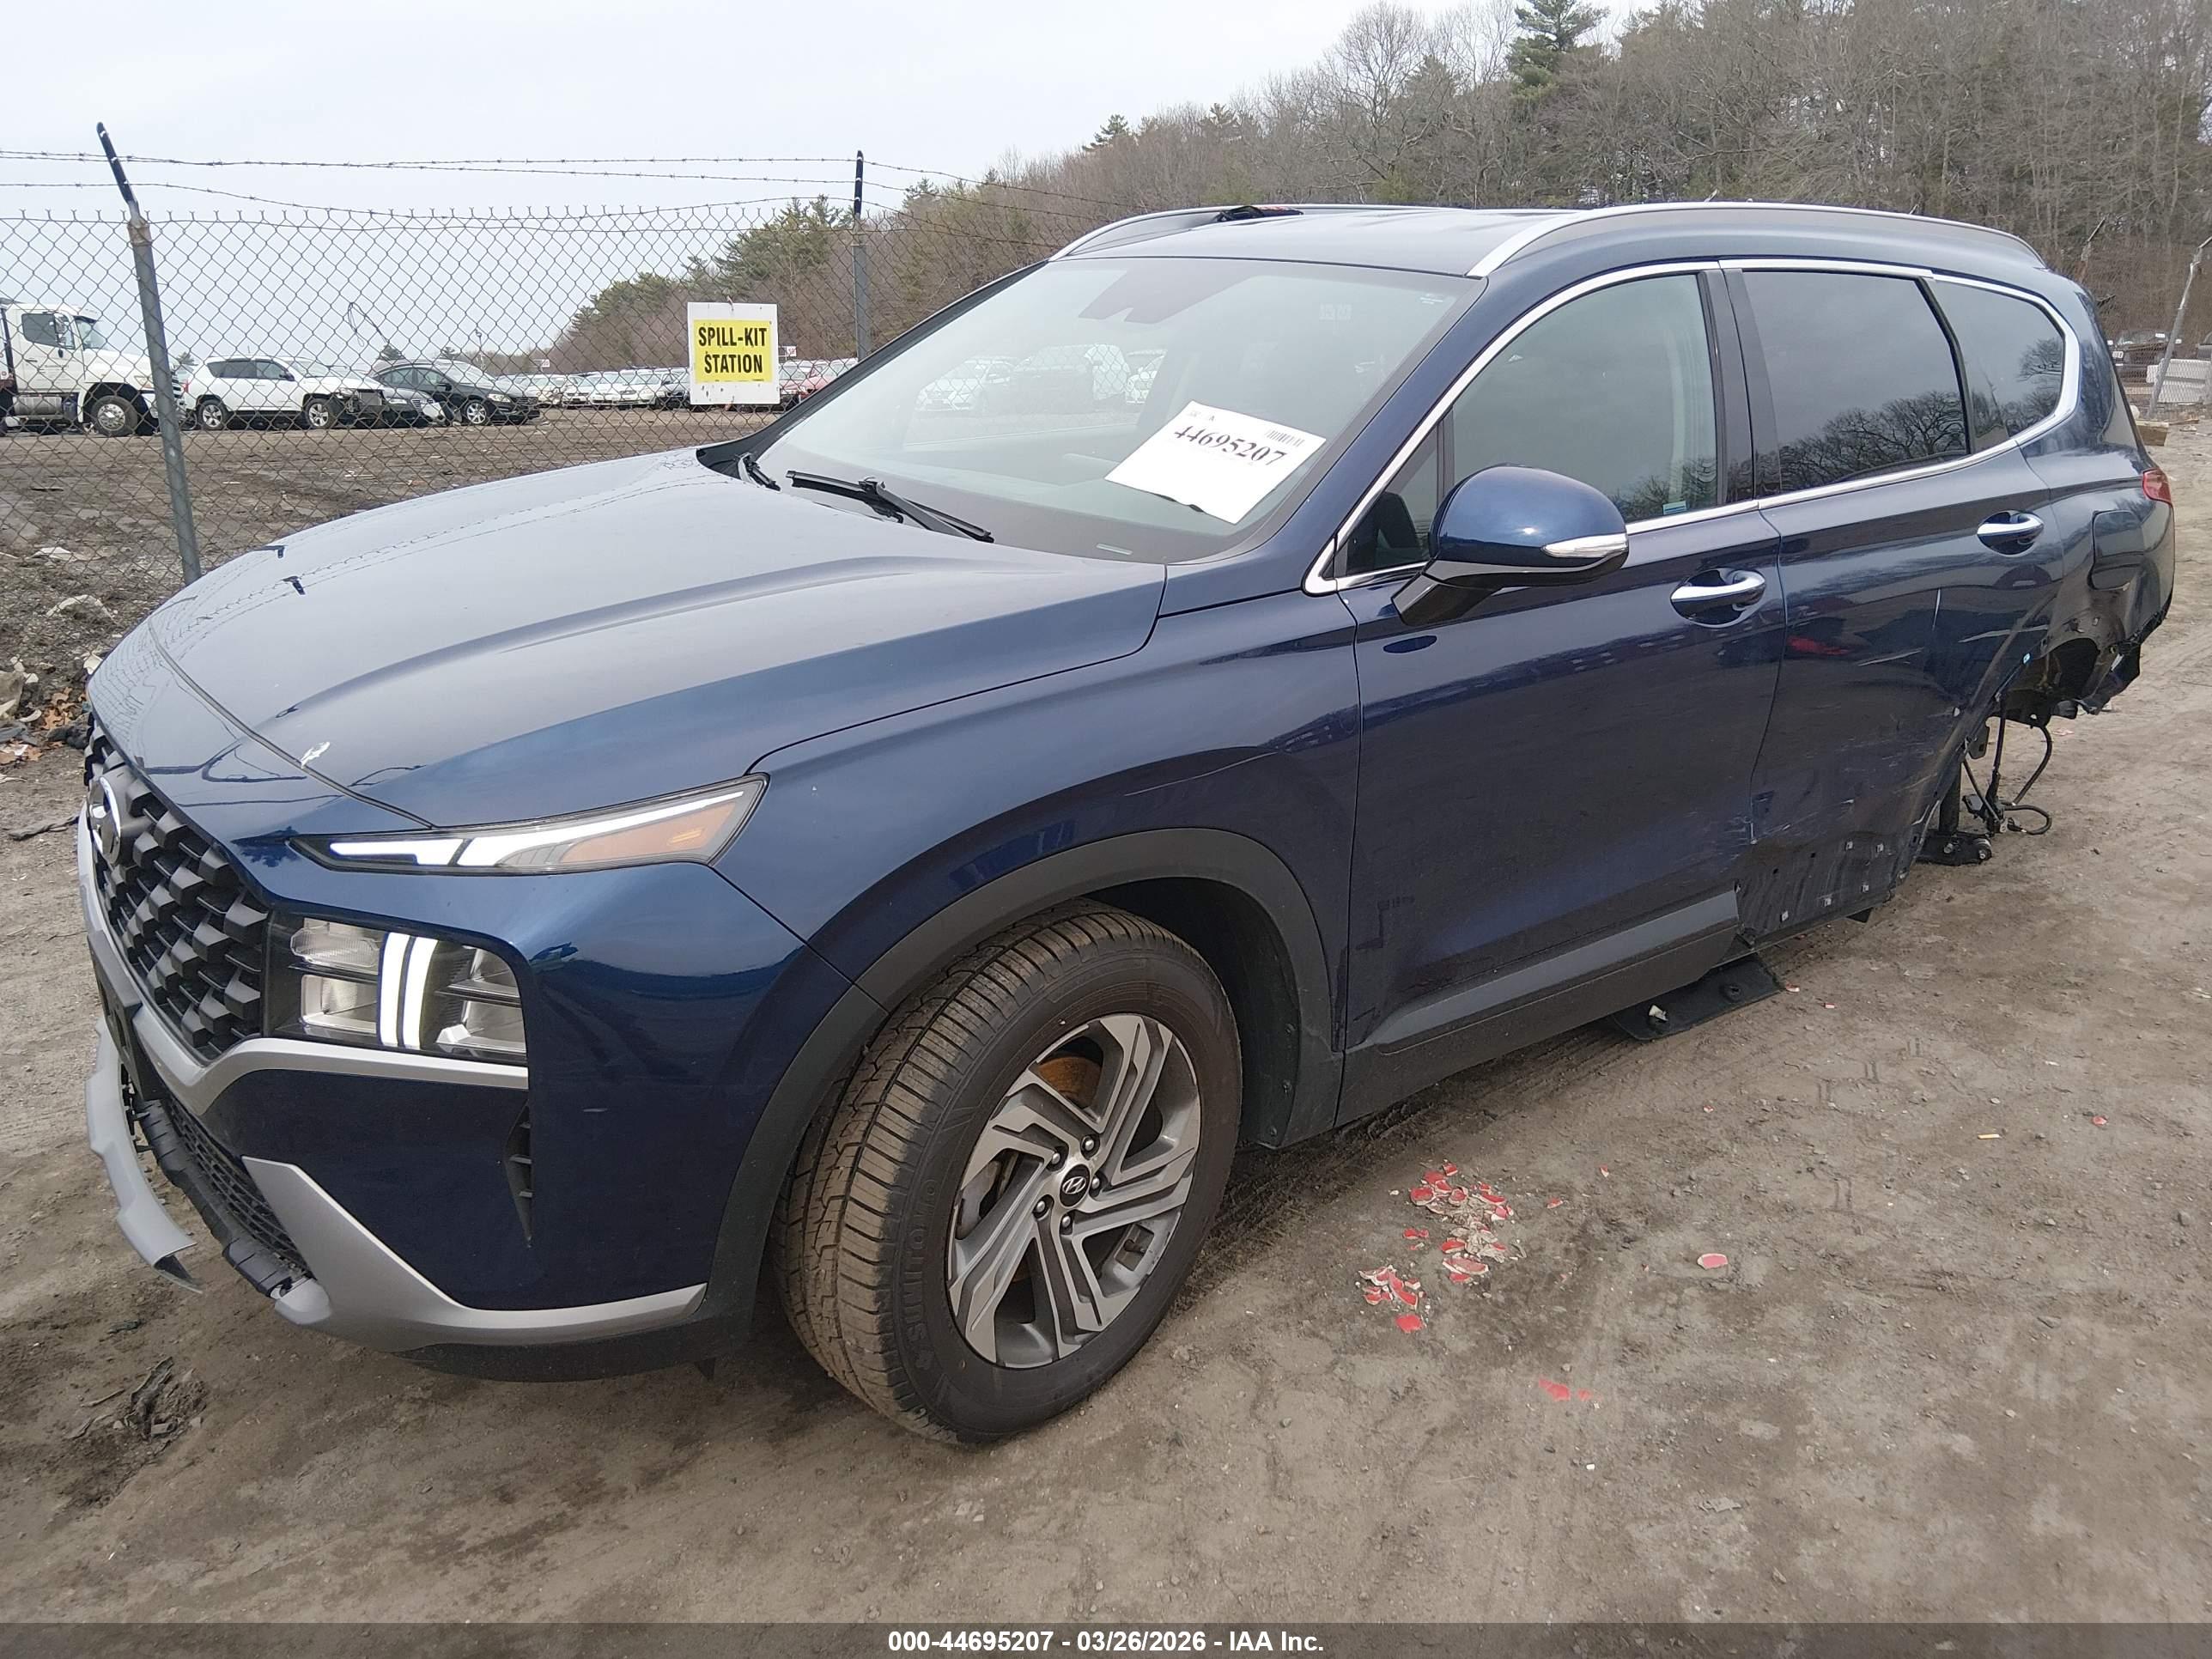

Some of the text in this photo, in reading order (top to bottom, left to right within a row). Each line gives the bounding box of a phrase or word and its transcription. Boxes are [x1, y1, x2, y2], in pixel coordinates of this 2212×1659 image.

[698, 326, 767, 346] SPILL-KIT
[704, 354, 763, 374] STATION
[1173, 425, 1288, 466] 44695207
